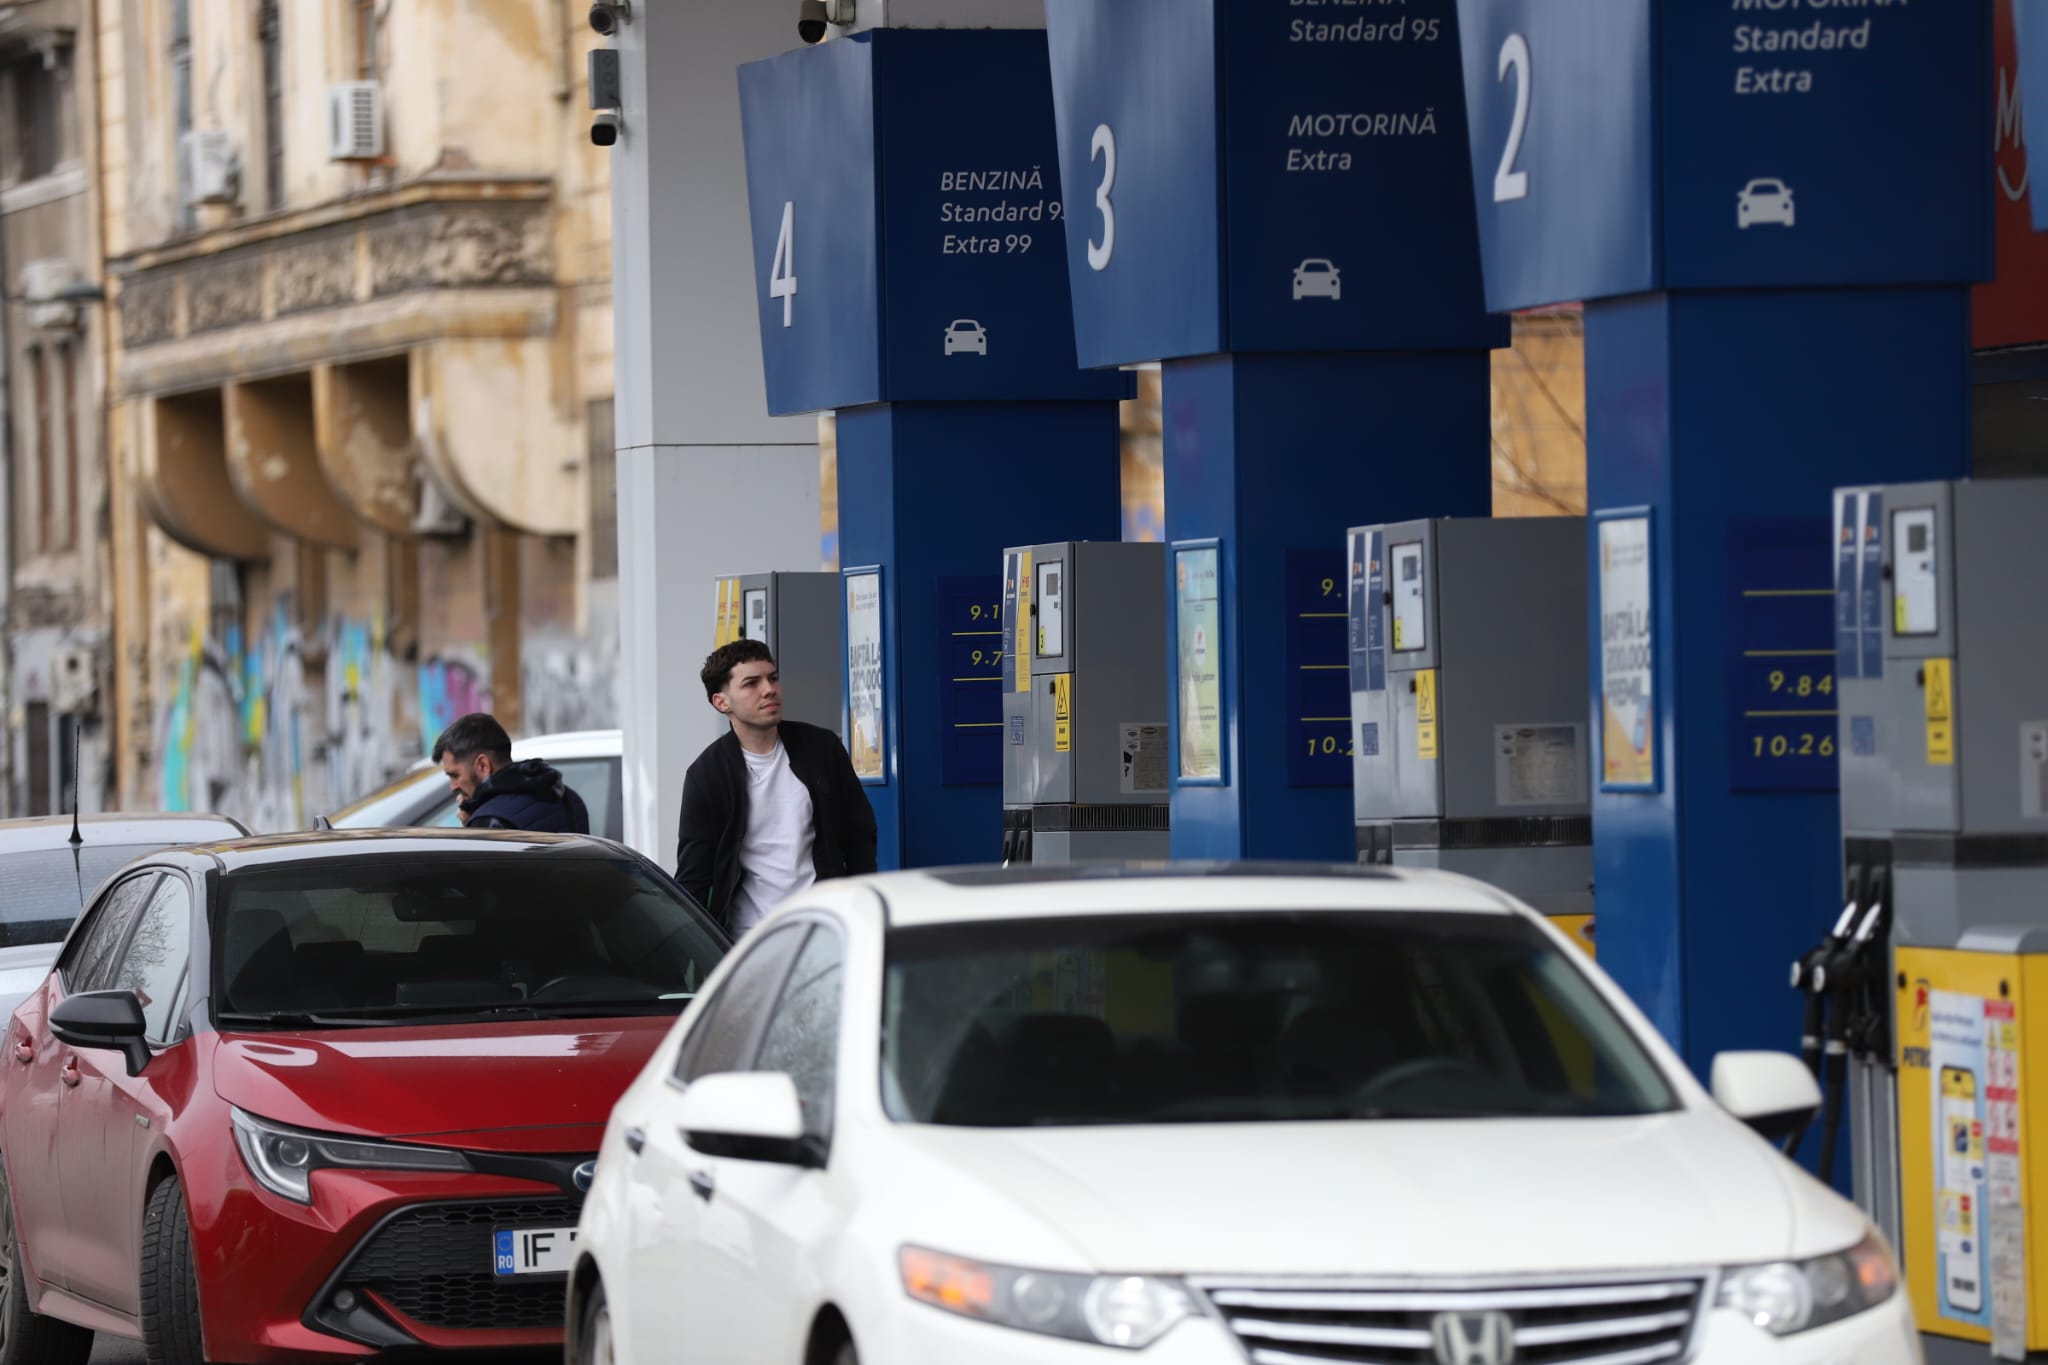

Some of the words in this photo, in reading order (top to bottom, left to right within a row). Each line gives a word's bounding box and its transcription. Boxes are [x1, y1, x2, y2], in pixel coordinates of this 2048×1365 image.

[1289, 16, 1406, 42] Standard
[1411, 18, 1441, 42] 95
[1733, 19, 1871, 52] Standard
[1735, 66, 1812, 94] Extra
[1288, 106, 1437, 137] MOTORINĂ
[1494, 33, 1531, 203] 2
[1286, 148, 1352, 172] Extra
[940, 164, 1043, 191] BENZINĂ
[940, 199, 1043, 222] Standard
[1048, 201, 1065, 220] 9
[1087, 123, 1116, 271] 3
[942, 234, 1000, 254] Extra
[1005, 234, 1032, 254] 99
[770, 201, 798, 328] 4
[1768, 669, 1833, 696] 9.84
[1752, 733, 1834, 757] 10.26
[498, 1255, 514, 1270] RO
[523, 1232, 555, 1268] IF
